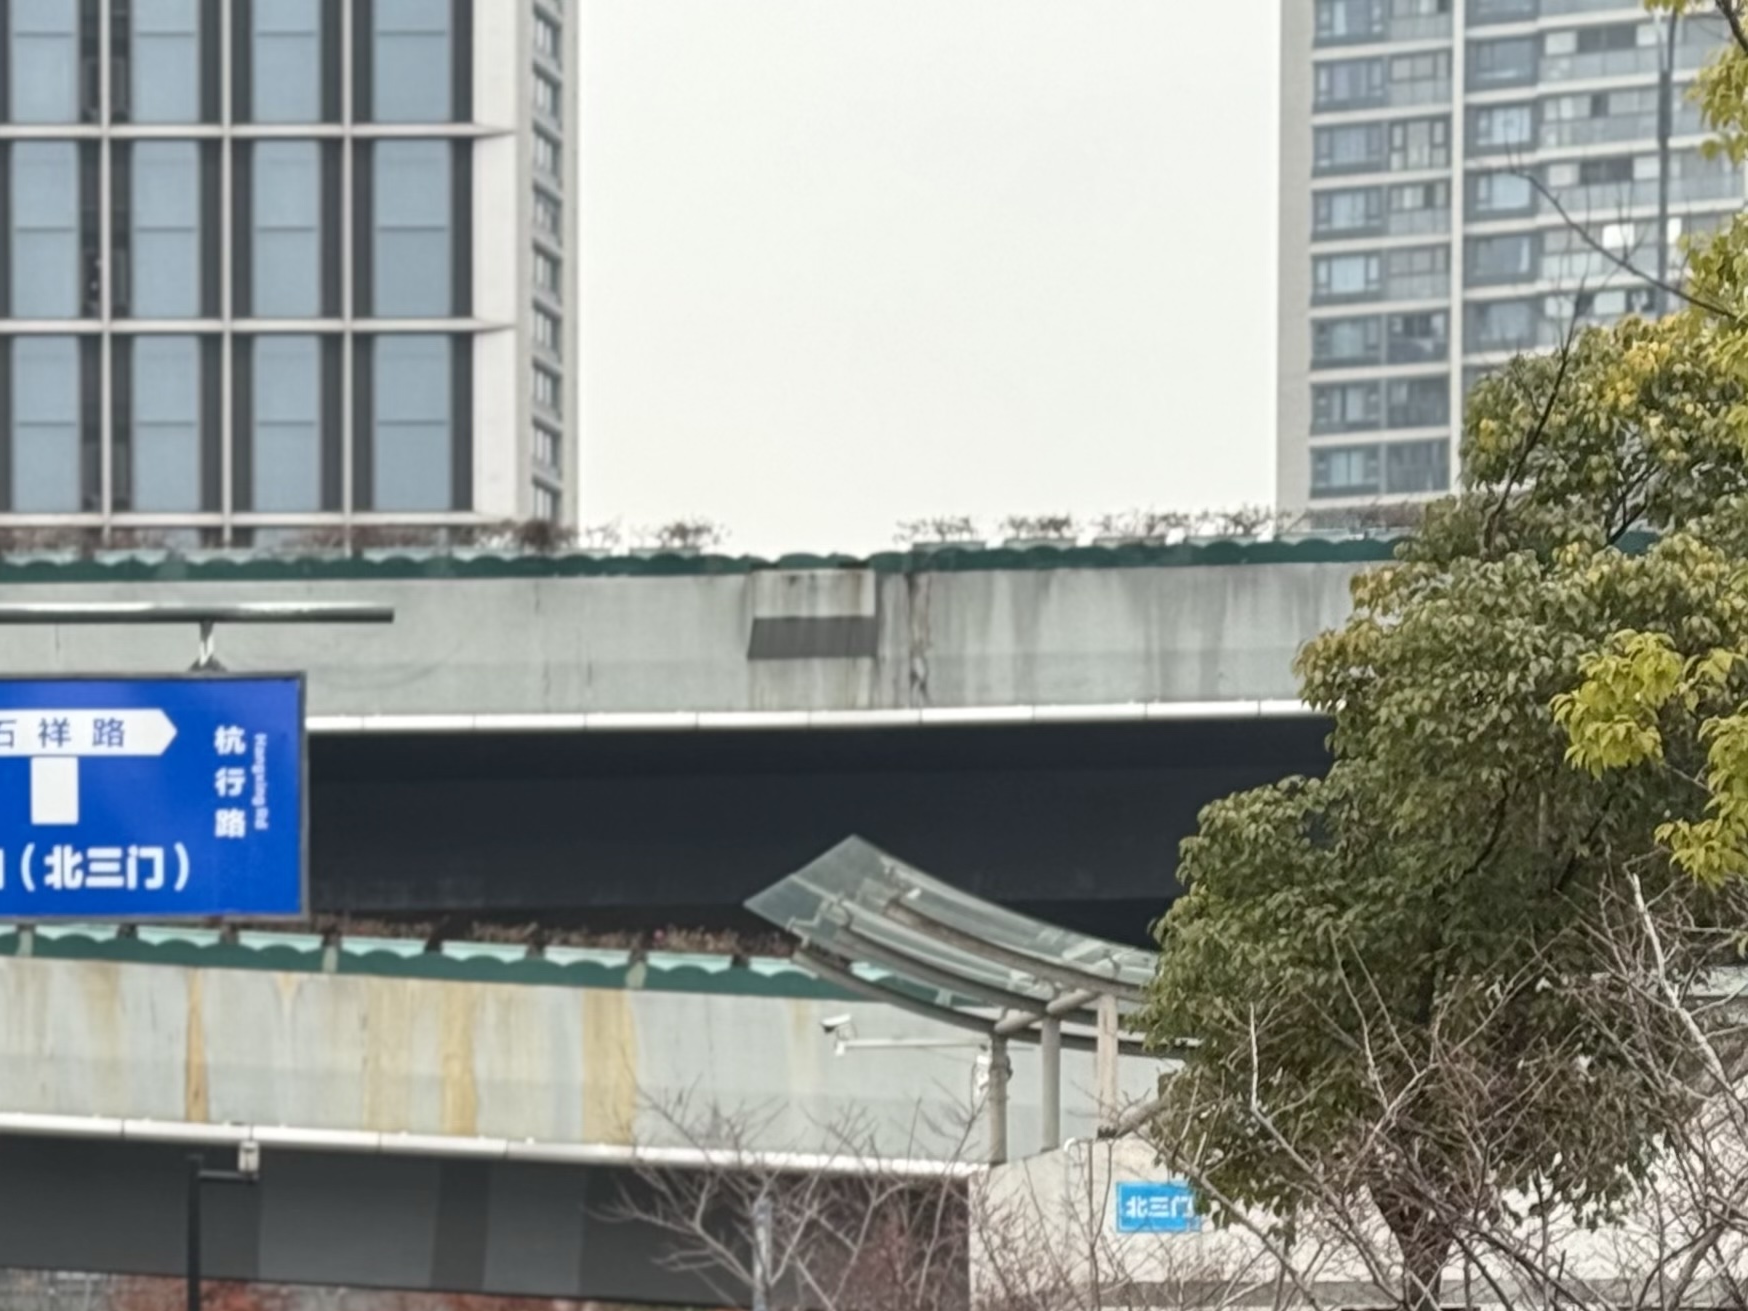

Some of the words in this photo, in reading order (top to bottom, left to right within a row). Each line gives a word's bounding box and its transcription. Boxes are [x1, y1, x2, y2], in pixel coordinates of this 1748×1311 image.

[214, 724, 247, 839] 杭行路
[1125, 1194, 1194, 1219] 北三门
